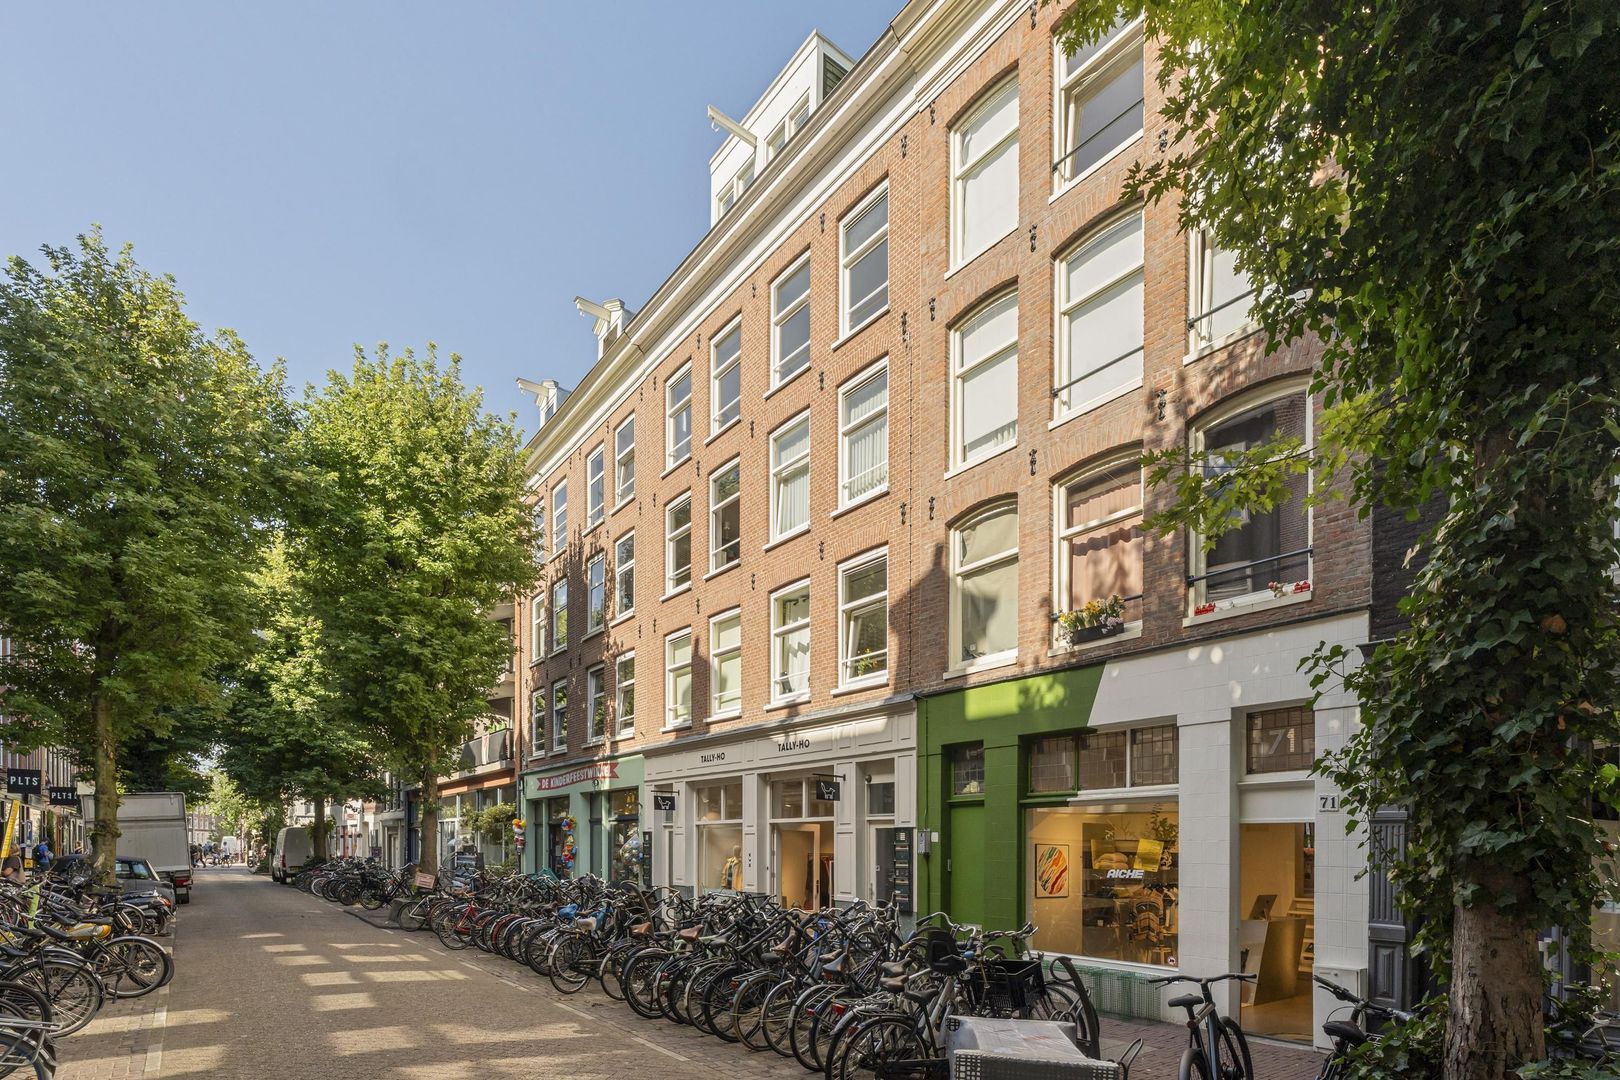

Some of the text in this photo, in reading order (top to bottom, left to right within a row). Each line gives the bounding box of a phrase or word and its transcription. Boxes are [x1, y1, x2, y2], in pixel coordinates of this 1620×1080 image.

[778, 739, 810, 752] TALLY-HO
[1269, 728, 1295, 754] 71
[701, 752, 725, 763] TALLY-HO
[10, 776, 38, 785] PLTS
[542, 765, 611, 789] DE KINDERFEESTWINKEL
[1320, 797, 1336, 808] 71
[1107, 869, 1144, 878] AICHE
